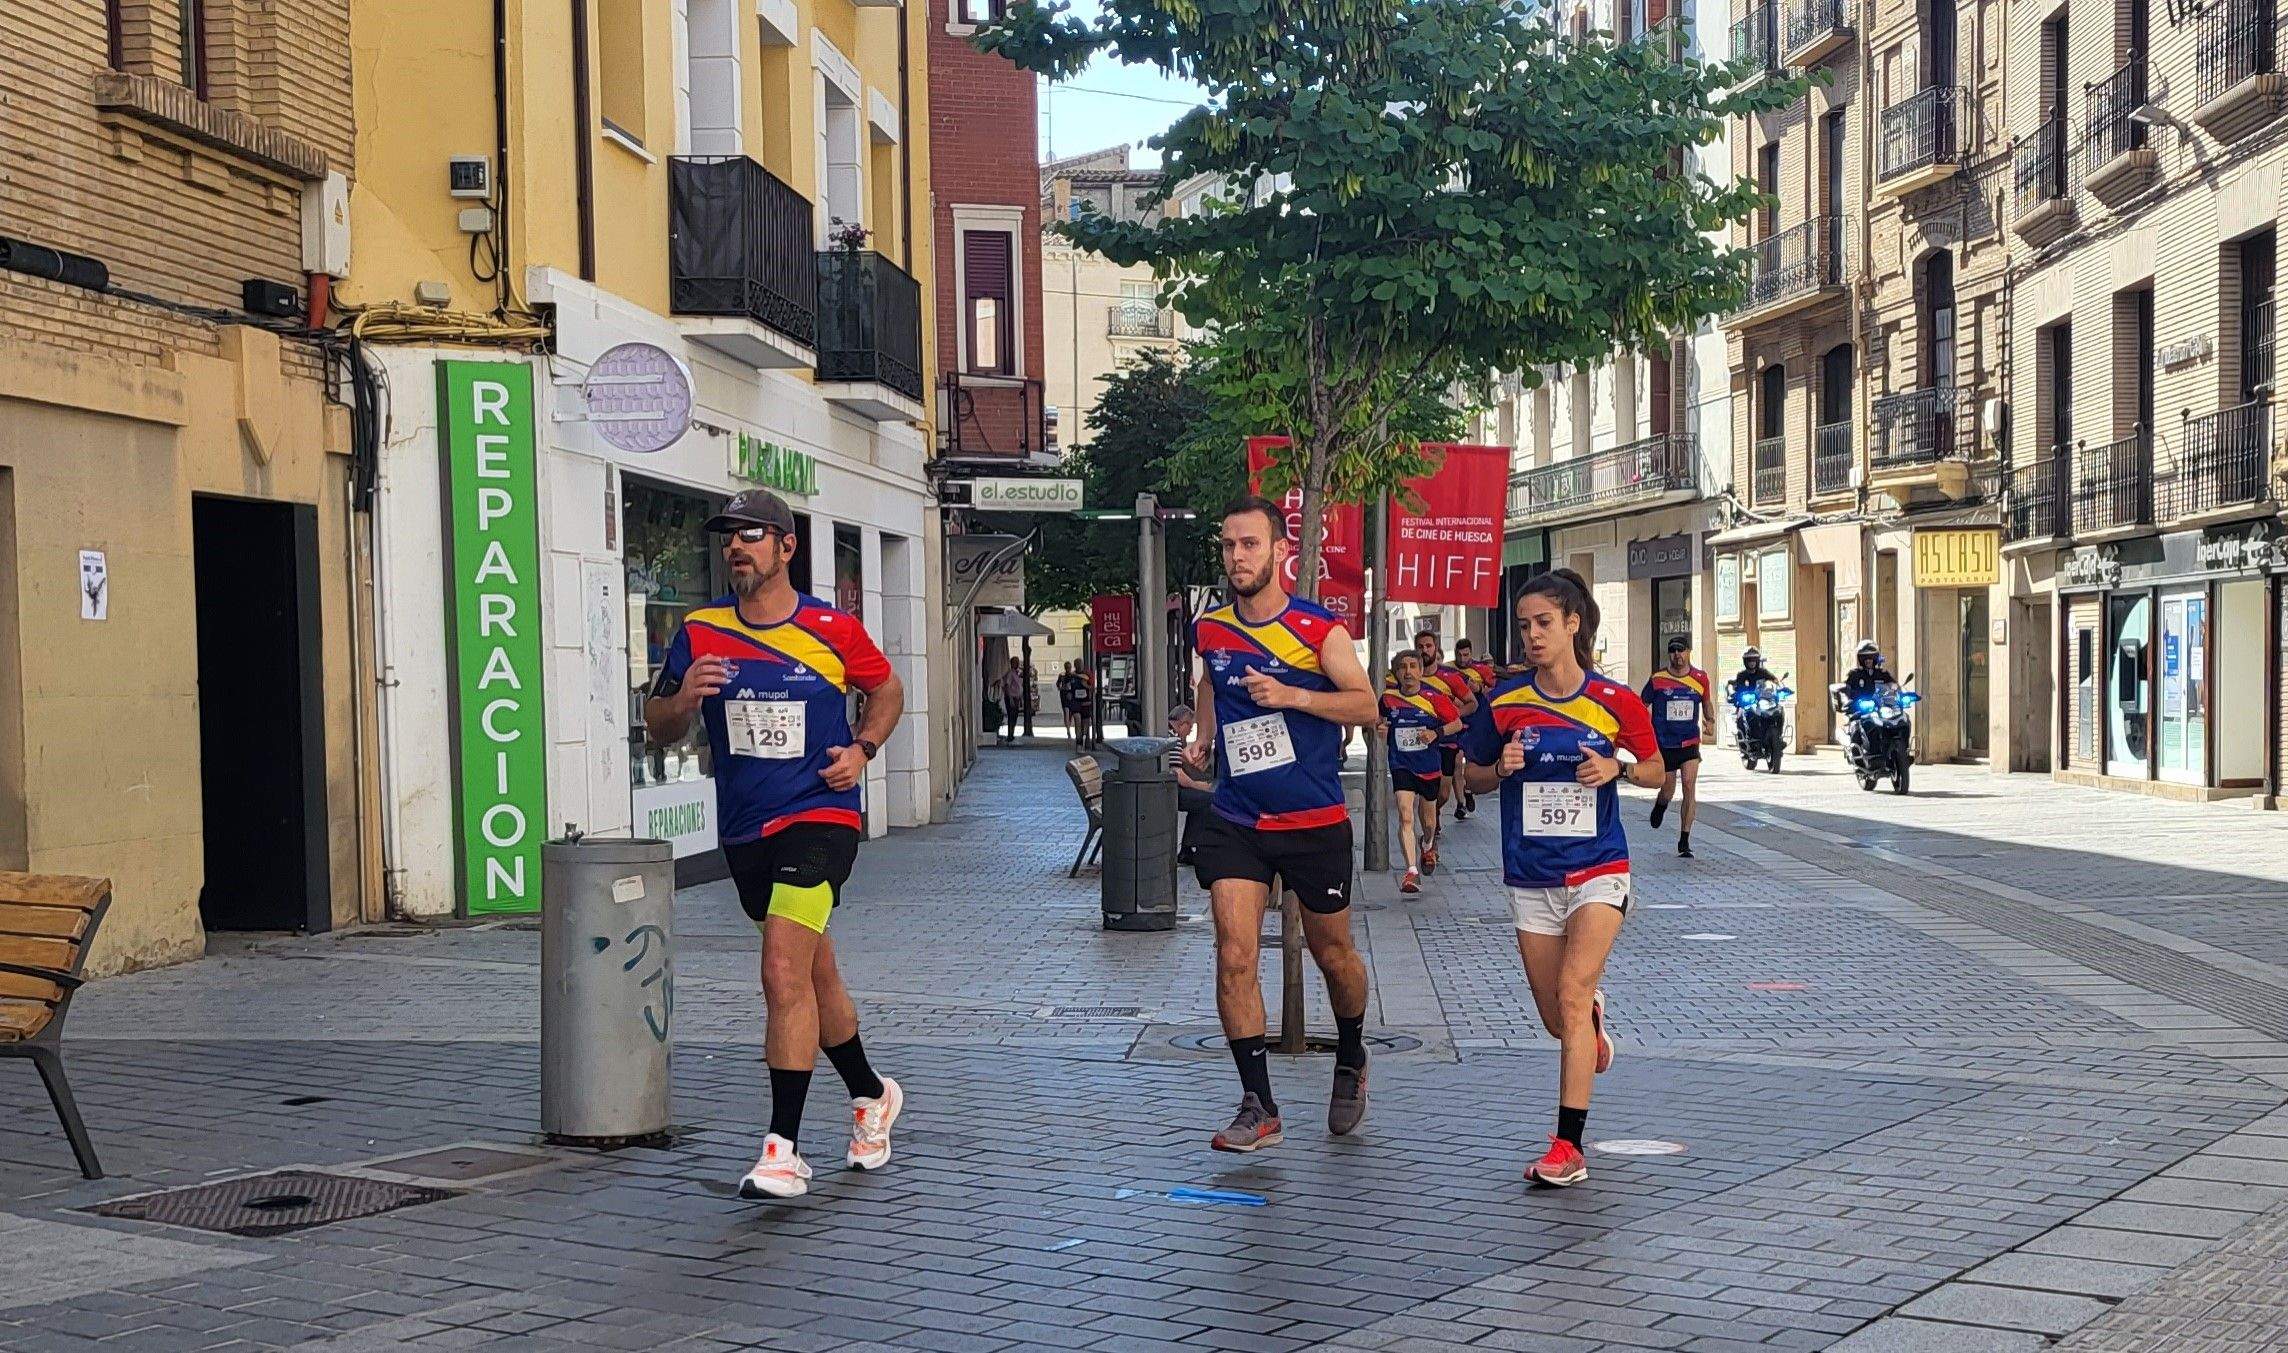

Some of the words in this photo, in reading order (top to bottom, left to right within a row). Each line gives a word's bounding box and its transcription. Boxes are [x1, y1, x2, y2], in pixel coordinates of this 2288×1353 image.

[1401, 517, 1434, 527] FESTIVAL
[1436, 516, 1493, 526] INTERNACIONAL
[1401, 528, 1415, 539] DE
[1416, 529, 1438, 540] CINE
[1440, 530, 1453, 541] DE
[1455, 531, 1494, 543] HUESCA
[1919, 533, 1993, 574] ASCASO
[1398, 552, 1493, 590] HIFF
[472, 380, 527, 900] REPARACION
[758, 688, 789, 700] mupol
[746, 728, 788, 749] 129
[1238, 740, 1277, 764] 598
[1556, 752, 1584, 763] mupol
[647, 800, 706, 839] REPARACIONES
[1540, 808, 1581, 826] 597
